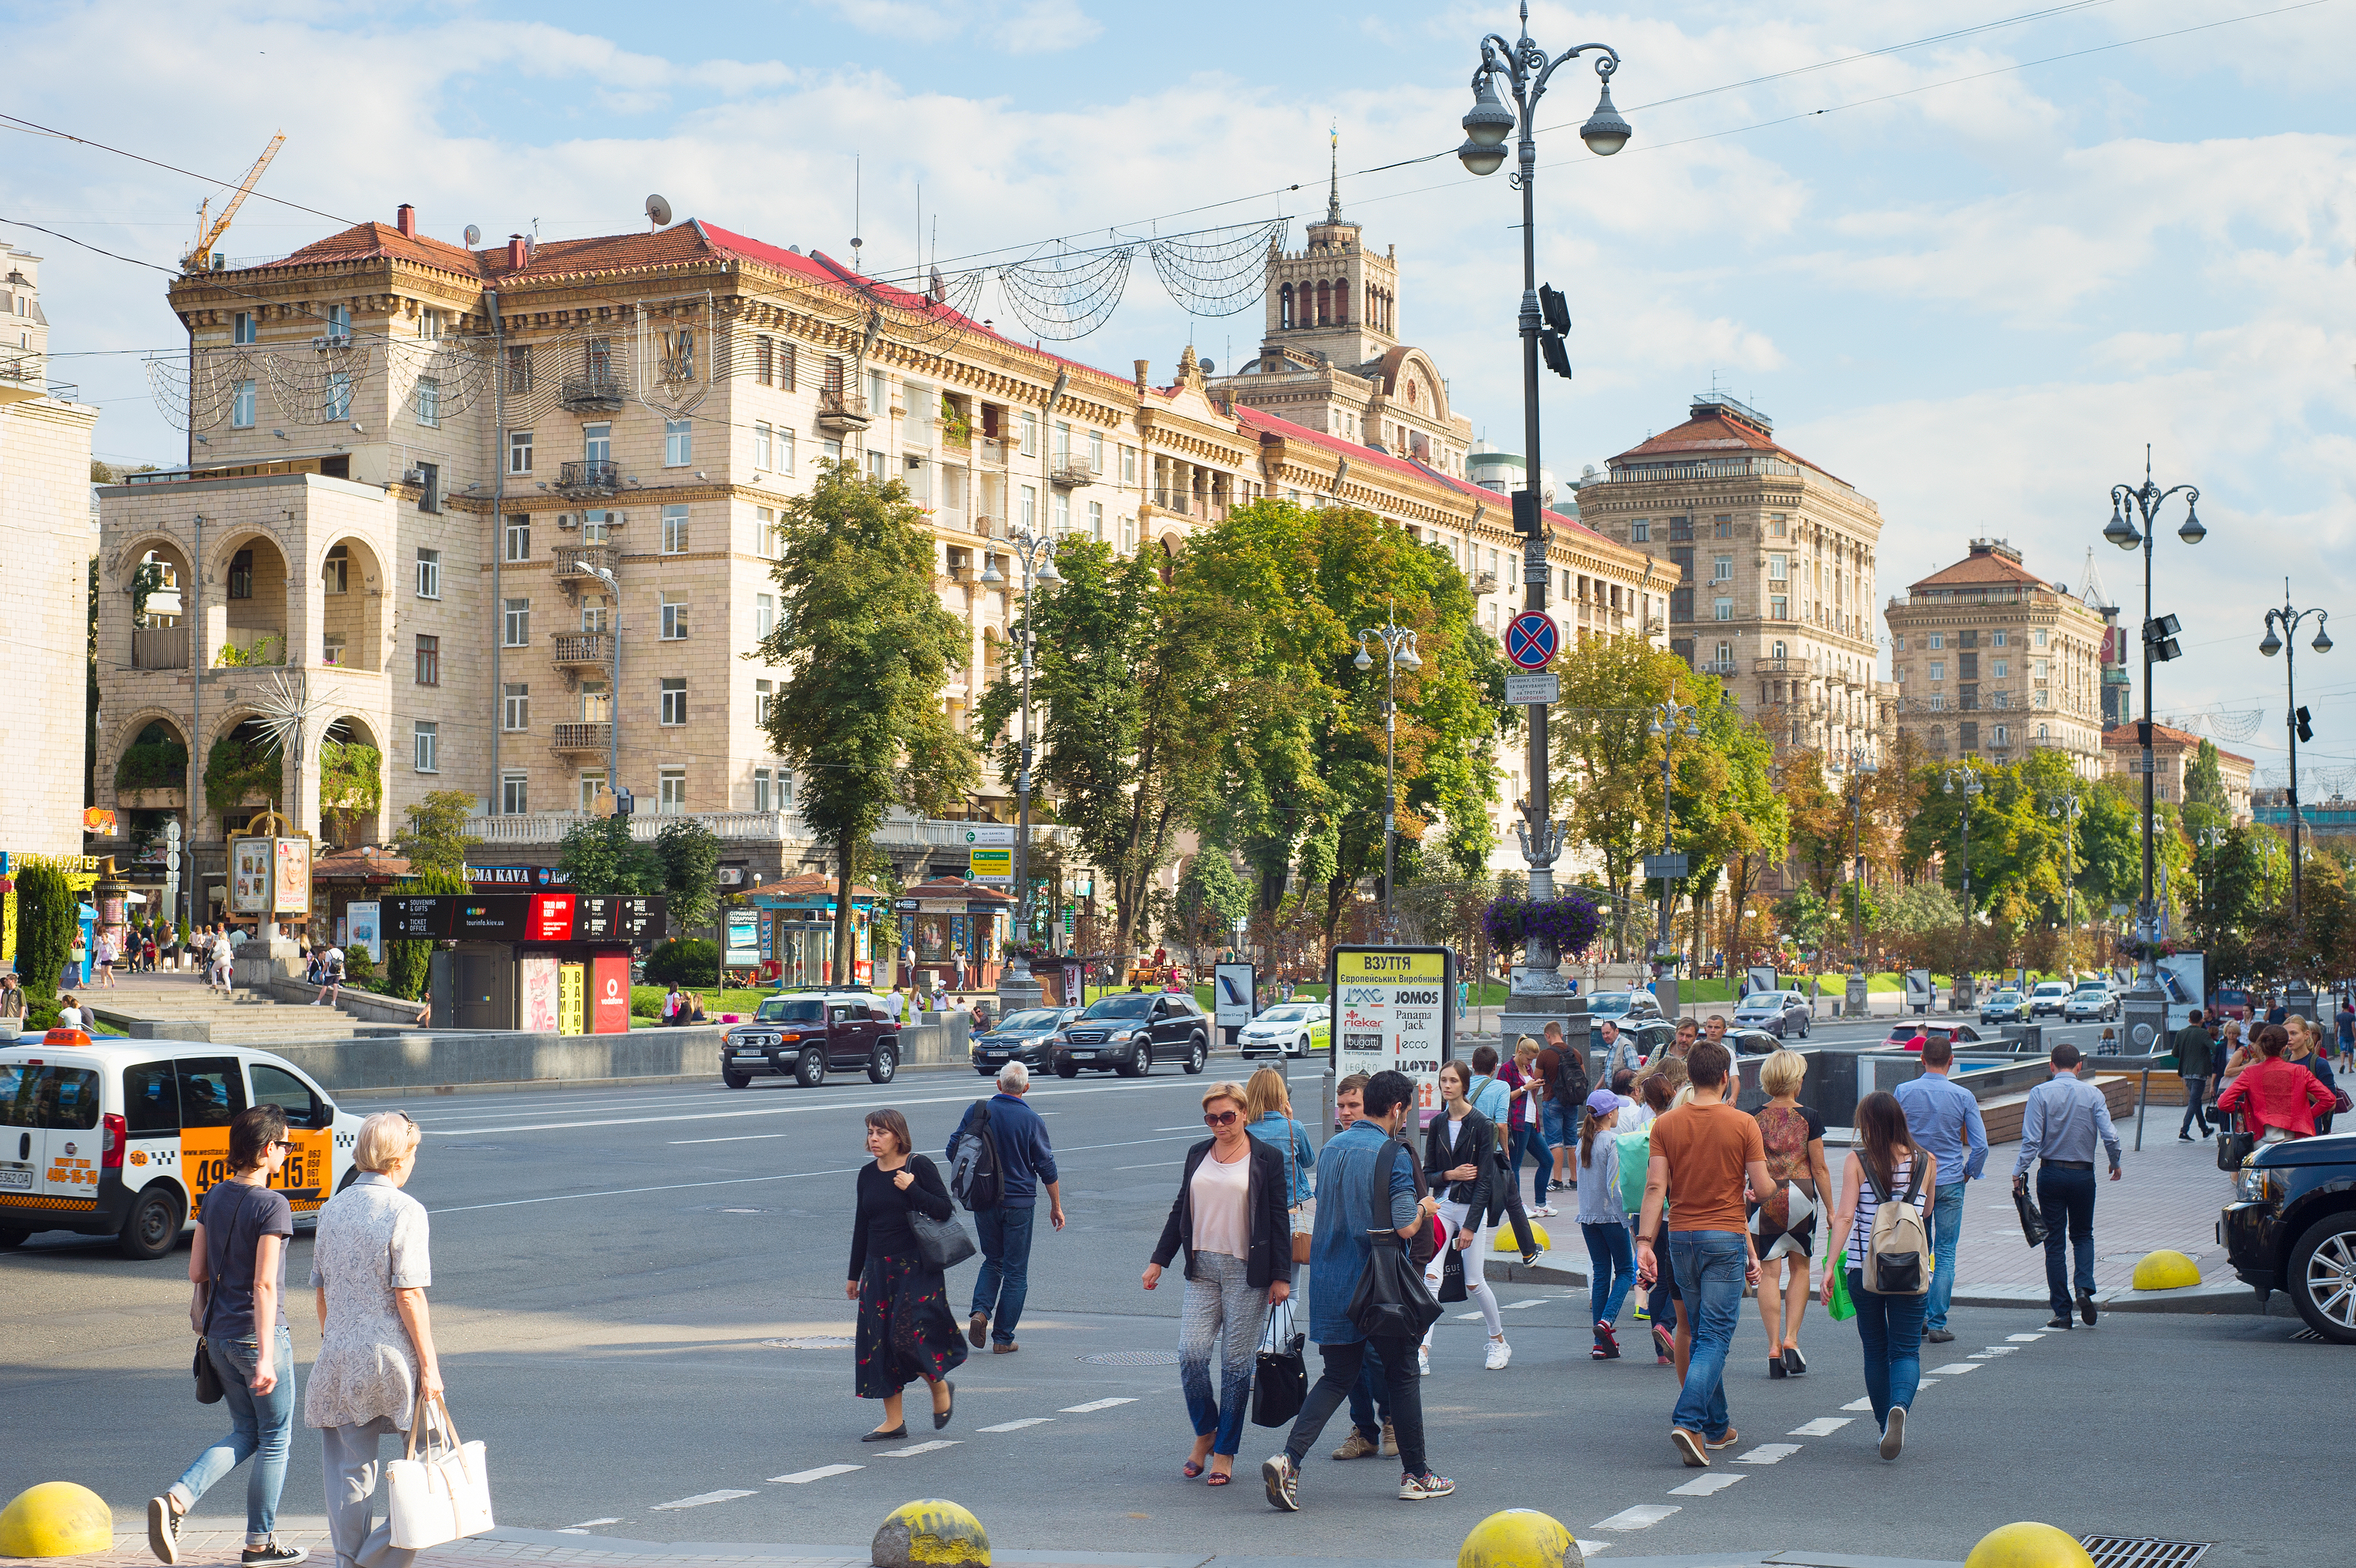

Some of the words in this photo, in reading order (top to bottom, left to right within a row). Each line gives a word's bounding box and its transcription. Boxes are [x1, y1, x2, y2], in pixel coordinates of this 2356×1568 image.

[495, 869, 529, 883] KAVA
[543, 901, 555, 909] TOUR
[543, 909, 554, 917] KIEV
[1364, 956, 1411, 970] ВЗУТТЯ
[1340, 974, 1397, 984] Європейських
[1399, 974, 1444, 985] Виробників
[601, 997, 624, 1005] vodafone
[1395, 991, 1439, 1004] JOMOS
[1396, 1010, 1432, 1019] Panama
[1344, 1017, 1384, 1027] rieker
[1403, 1020, 1424, 1032] Jack
[1348, 1036, 1379, 1049] bugatti
[1402, 1040, 1428, 1049] ecco
[1395, 1060, 1439, 1072] LLOYD
[130, 1153, 146, 1165] 502
[308, 1150, 321, 1158] 063
[307, 1159, 320, 1168] 050
[46, 1167, 98, 1185] 495-15-15
[307, 1168, 319, 1177] 067
[307, 1178, 320, 1187] 044
